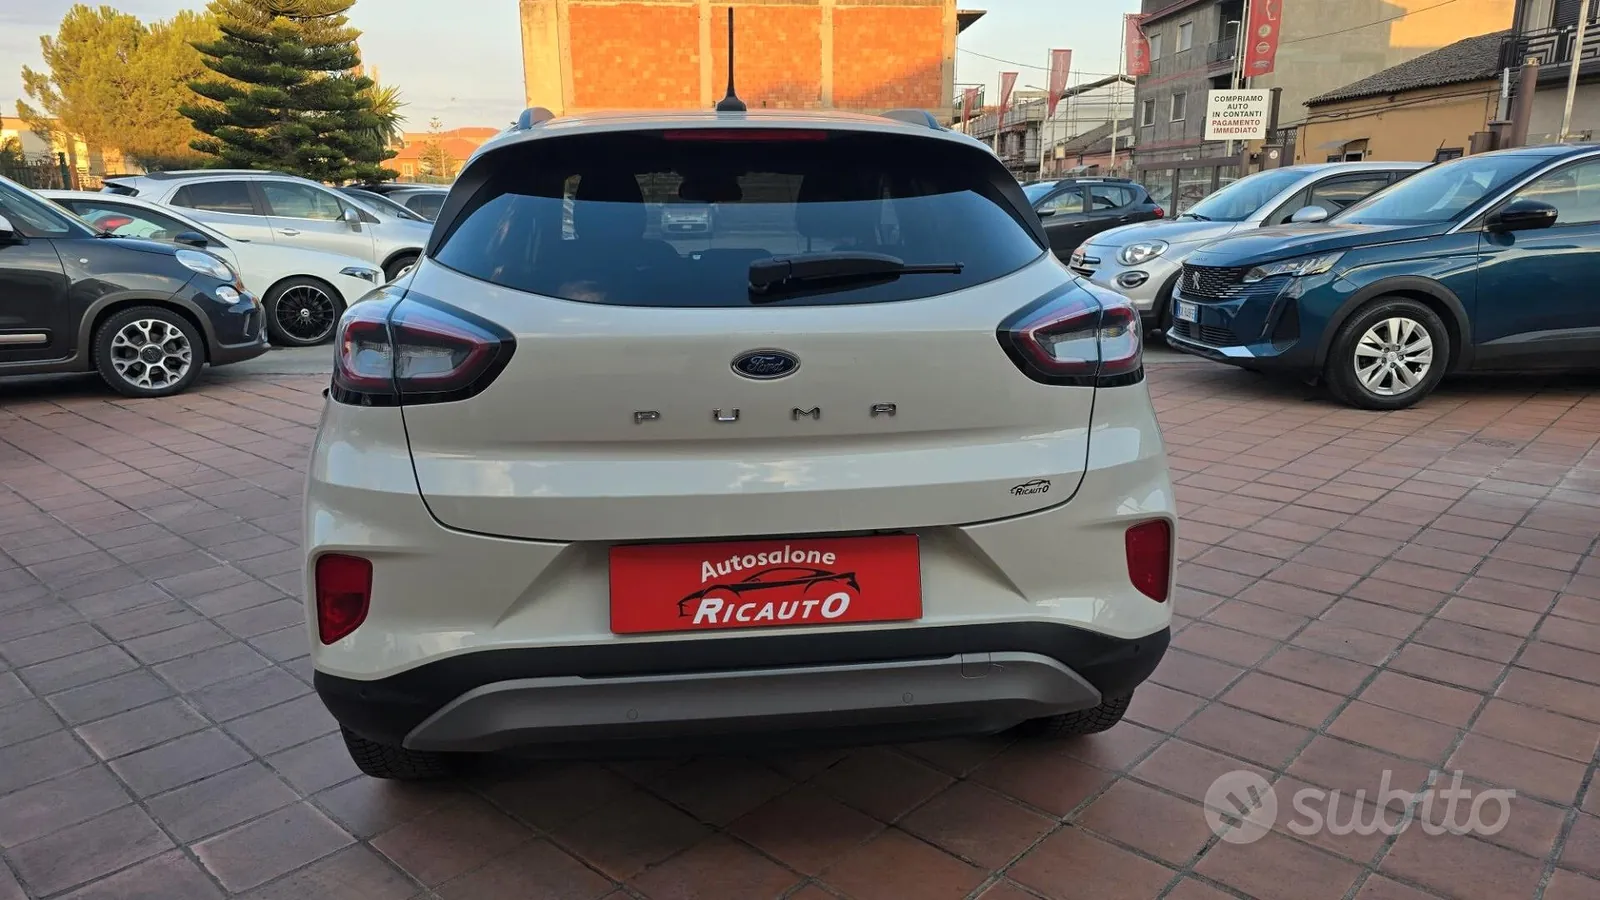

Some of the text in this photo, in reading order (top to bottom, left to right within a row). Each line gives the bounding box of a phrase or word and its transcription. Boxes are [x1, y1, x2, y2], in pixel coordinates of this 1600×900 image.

[1214, 95, 1264, 103] COMPRIAMO
[1223, 110, 1262, 118] CONTANTI
[1213, 126, 1258, 134] IMMEDIATO
[746, 355, 785, 374] Ford
[633, 402, 898, 425] PUMA
[1014, 484, 1050, 496] RICAUTO
[701, 544, 837, 583] Autosalone
[692, 591, 851, 625] RICAUTO
